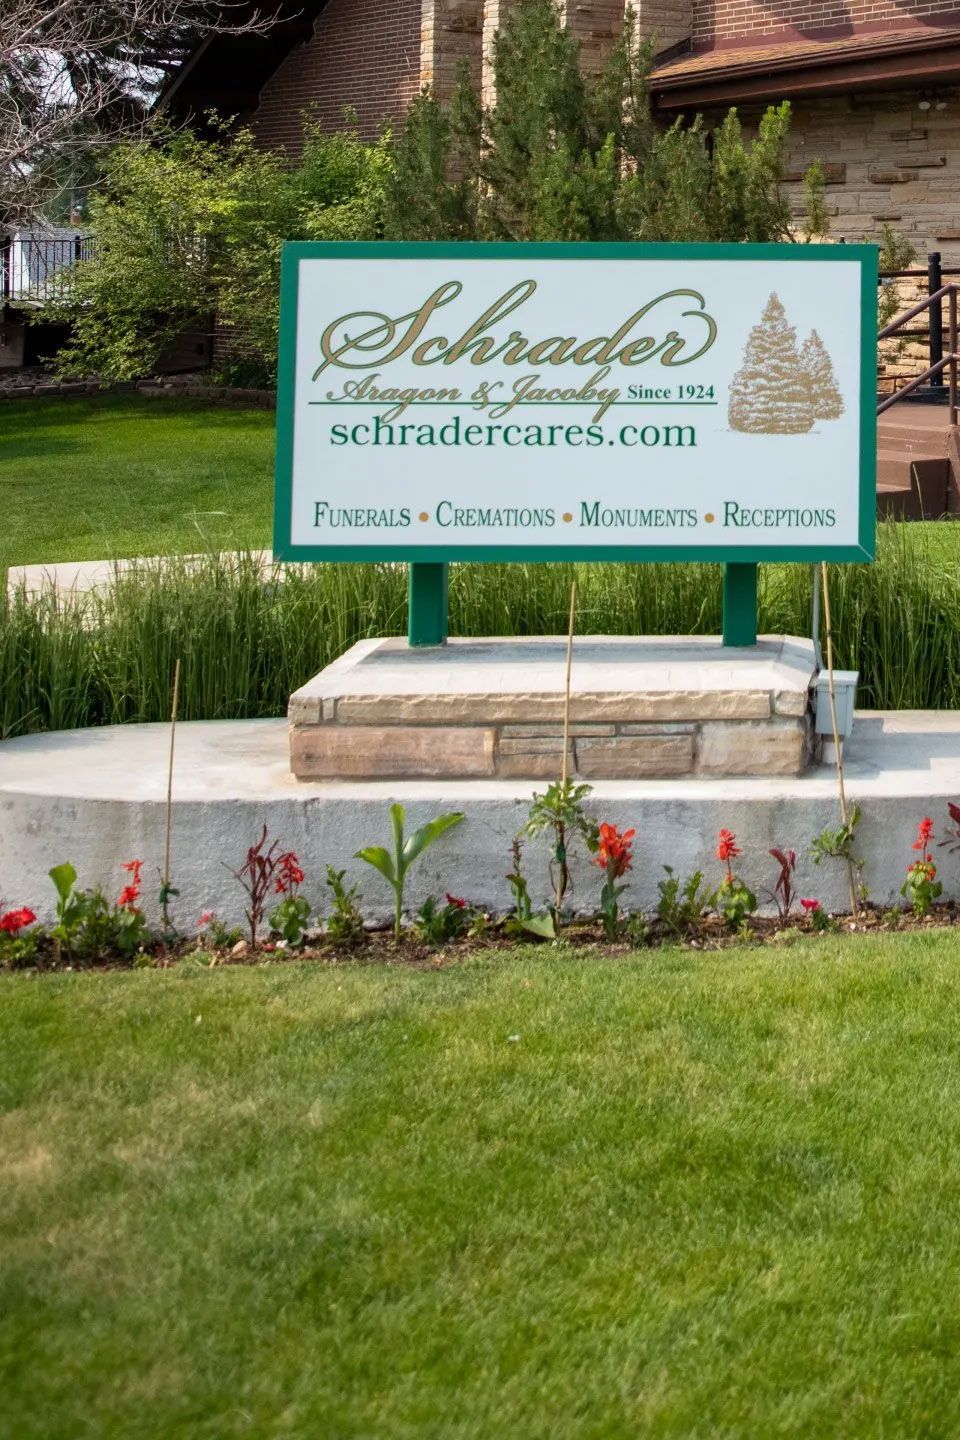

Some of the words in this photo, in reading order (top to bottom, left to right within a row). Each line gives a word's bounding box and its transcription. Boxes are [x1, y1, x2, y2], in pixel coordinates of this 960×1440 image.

[312, 279, 718, 382] Schrader
[326, 373, 462, 424] Aragon
[471, 381, 504, 410] &
[488, 366, 621, 424] Jacoby
[627, 384, 672, 400] Since
[678, 384, 715, 400] 1924
[330, 416, 698, 447] schradercares.com
[313, 501, 411, 527] FUNERALS
[436, 501, 556, 527] CREMATIONS
[579, 501, 698, 527] MONUMENTS
[722, 501, 836, 527] RECEPTIONS
